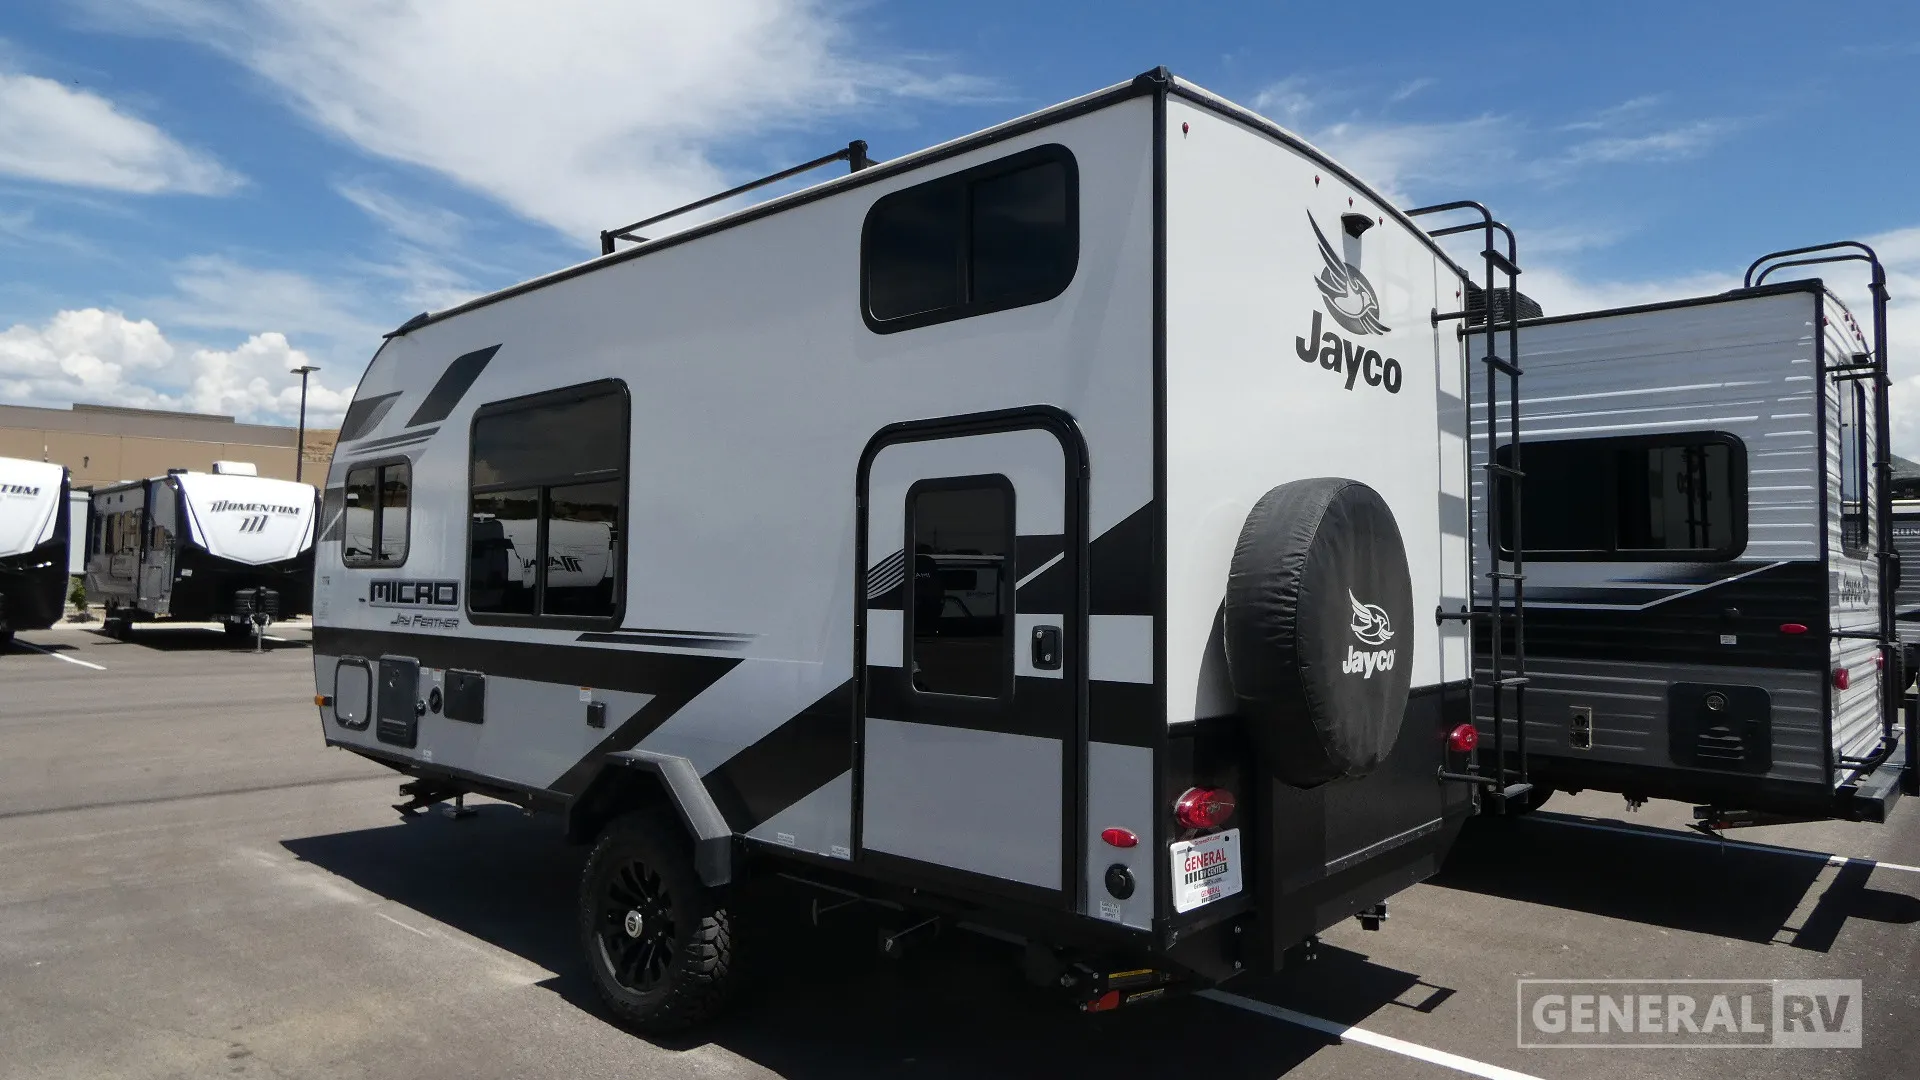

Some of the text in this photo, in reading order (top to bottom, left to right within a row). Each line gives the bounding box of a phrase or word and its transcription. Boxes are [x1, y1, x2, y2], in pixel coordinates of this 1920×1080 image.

[1295, 309, 1403, 394] Jayco
[210, 500, 301, 515] MOMENTUM
[370, 581, 458, 606] MICRO
[1342, 645, 1395, 679] Jayco
[1185, 848, 1226, 872] GENERAL
